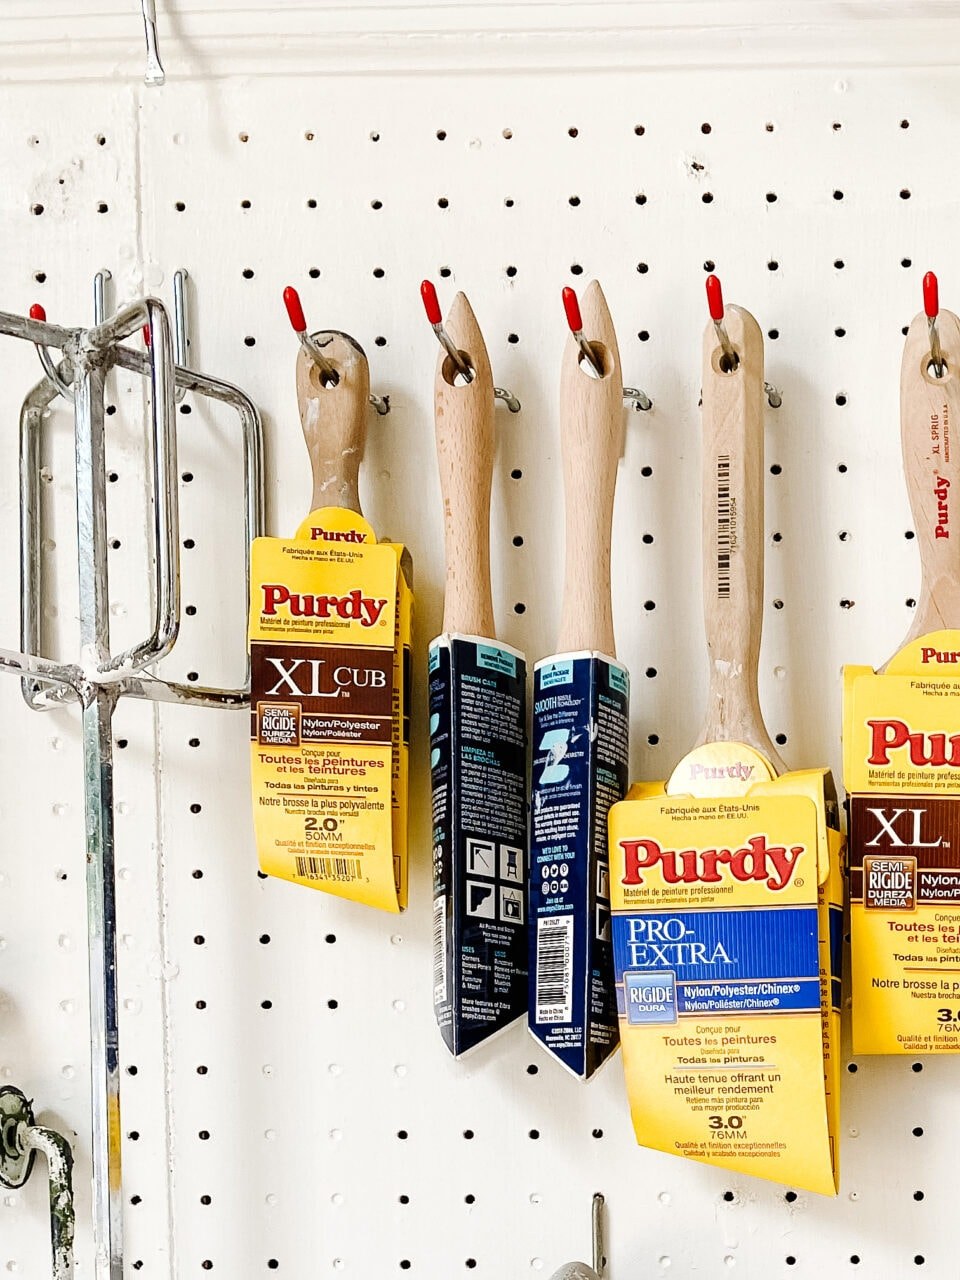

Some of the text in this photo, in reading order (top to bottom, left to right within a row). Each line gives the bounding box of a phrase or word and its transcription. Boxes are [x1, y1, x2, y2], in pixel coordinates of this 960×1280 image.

[931, 415, 939, 454] XL SPRIG
[935, 476, 950, 538] Purdy
[311, 528, 367, 543] Purdy
[262, 585, 387, 627] Purdy
[266, 658, 386, 697] XL CUB
[911, 682, 951, 691] Fabriquée
[265, 709, 293, 717] SEMI-
[262, 716, 295, 731] RIGIDE
[303, 719, 380, 730] Nylon/Polyester
[303, 729, 362, 738] Nylon/Poliéster
[258, 754, 384, 772] Toutes les peintures
[309, 766, 366, 776] teintures
[690, 762, 755, 781] Purdy
[661, 805, 700, 815] Fabriquée
[719, 804, 760, 812] États-Unis
[866, 808, 943, 847] XL
[305, 833, 343, 841] 50MM
[620, 836, 804, 890] Purdy
[872, 862, 908, 872] SEMI-
[869, 872, 912, 890] RIGIDE
[868, 890, 913, 899] DUREZA
[935, 914, 960, 924] Conçue
[626, 918, 694, 943] PRO-
[887, 922, 934, 932] Toutes
[938, 924, 955, 932] les
[922, 935, 938, 943] les
[628, 942, 731, 966] EXTRA
[893, 954, 923, 962] Todas
[872, 978, 900, 988] Notre
[903, 979, 937, 989] brosse
[941, 979, 950, 989] la
[630, 987, 673, 1003] RIGIDE
[663, 1037, 701, 1046] Toutes
[721, 1035, 777, 1047] peintures
[897, 1035, 922, 1043] Qualité
[664, 1074, 695, 1083] Haute
[698, 1075, 727, 1083] tenue
[730, 1073, 765, 1083] offrant
[674, 1085, 774, 1095] meilleur rendement
[710, 1131, 747, 1139] 76MM
